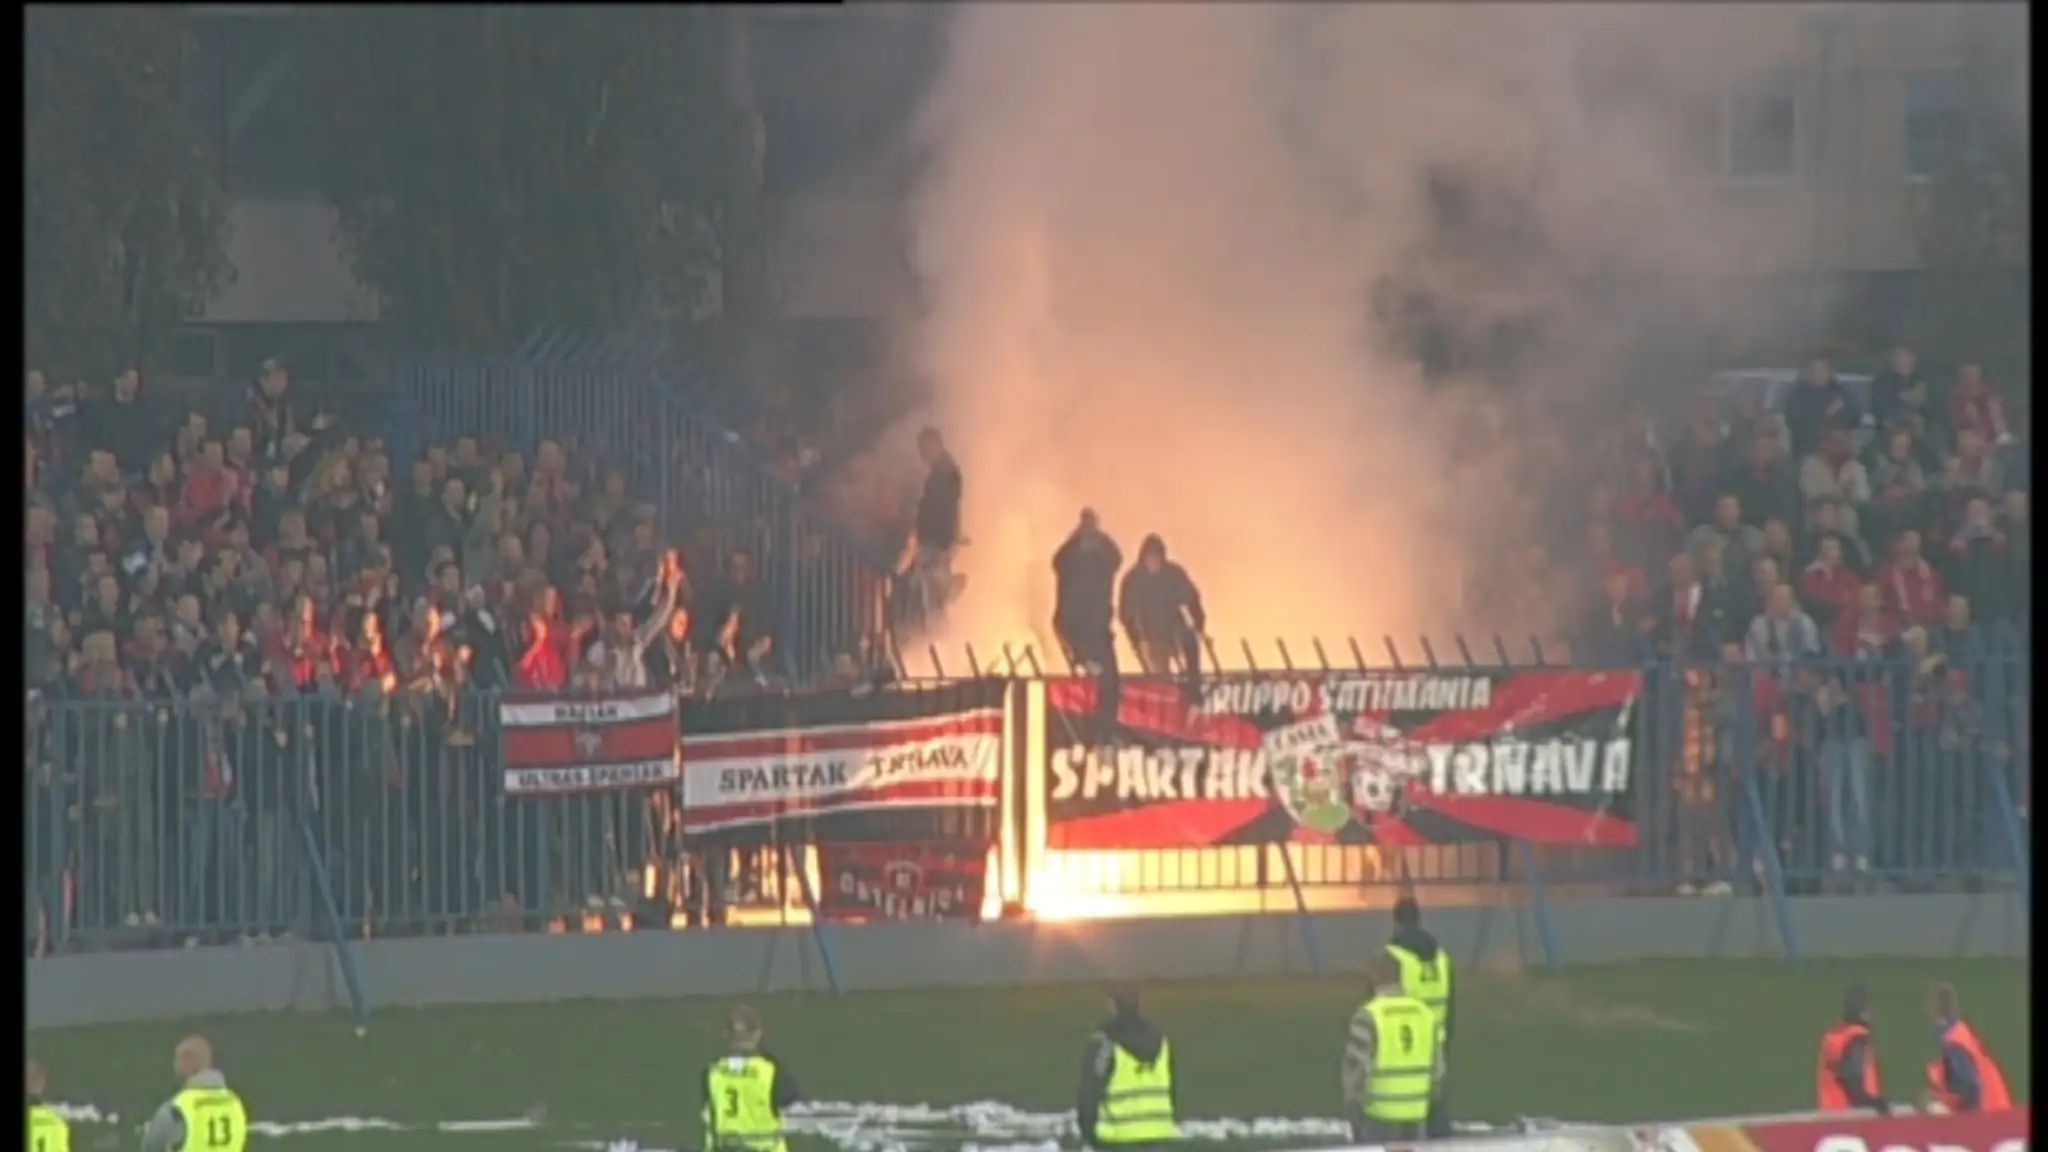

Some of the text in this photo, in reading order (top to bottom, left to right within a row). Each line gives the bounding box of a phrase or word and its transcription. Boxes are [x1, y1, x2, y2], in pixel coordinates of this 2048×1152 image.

[719, 760, 848, 793] SPARTAK
[1051, 743, 1269, 799] SPARTAK
[723, 1086, 739, 1118] 3
[207, 1115, 232, 1148] 13
